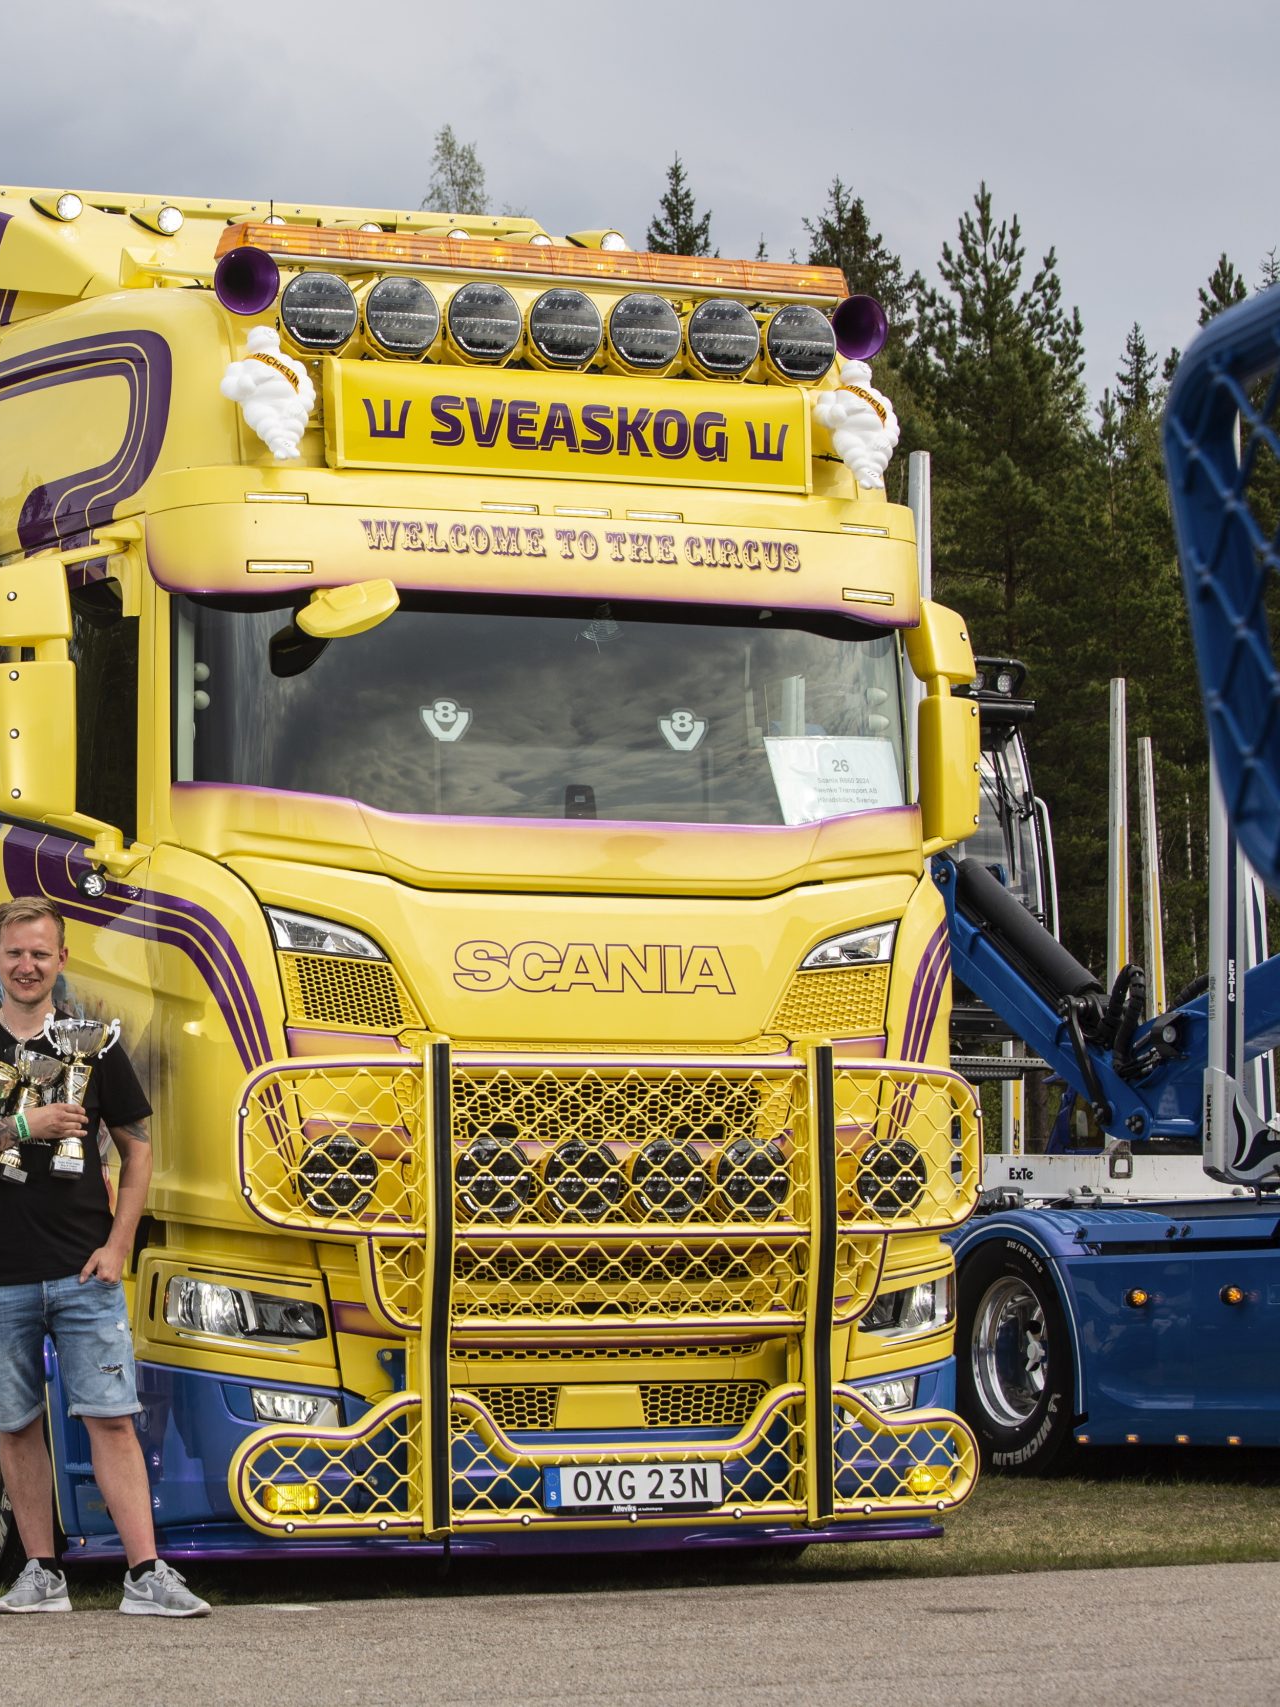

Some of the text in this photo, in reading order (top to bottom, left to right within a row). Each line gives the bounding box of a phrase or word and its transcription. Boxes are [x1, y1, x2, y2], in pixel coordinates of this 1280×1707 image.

[254, 352, 300, 388] MICHELIN
[430, 394, 728, 462] SVEASKOG
[359, 518, 801, 573] WELCOME TO THE CIRCUS
[831, 759, 850, 773] 26
[453, 939, 737, 995] SCANIA
[1008, 1167, 1034, 1181] ExTe
[992, 1415, 1052, 1466] MICHELIN
[549, 1491, 557, 1501] S
[573, 1467, 709, 1502] OXG 23N
